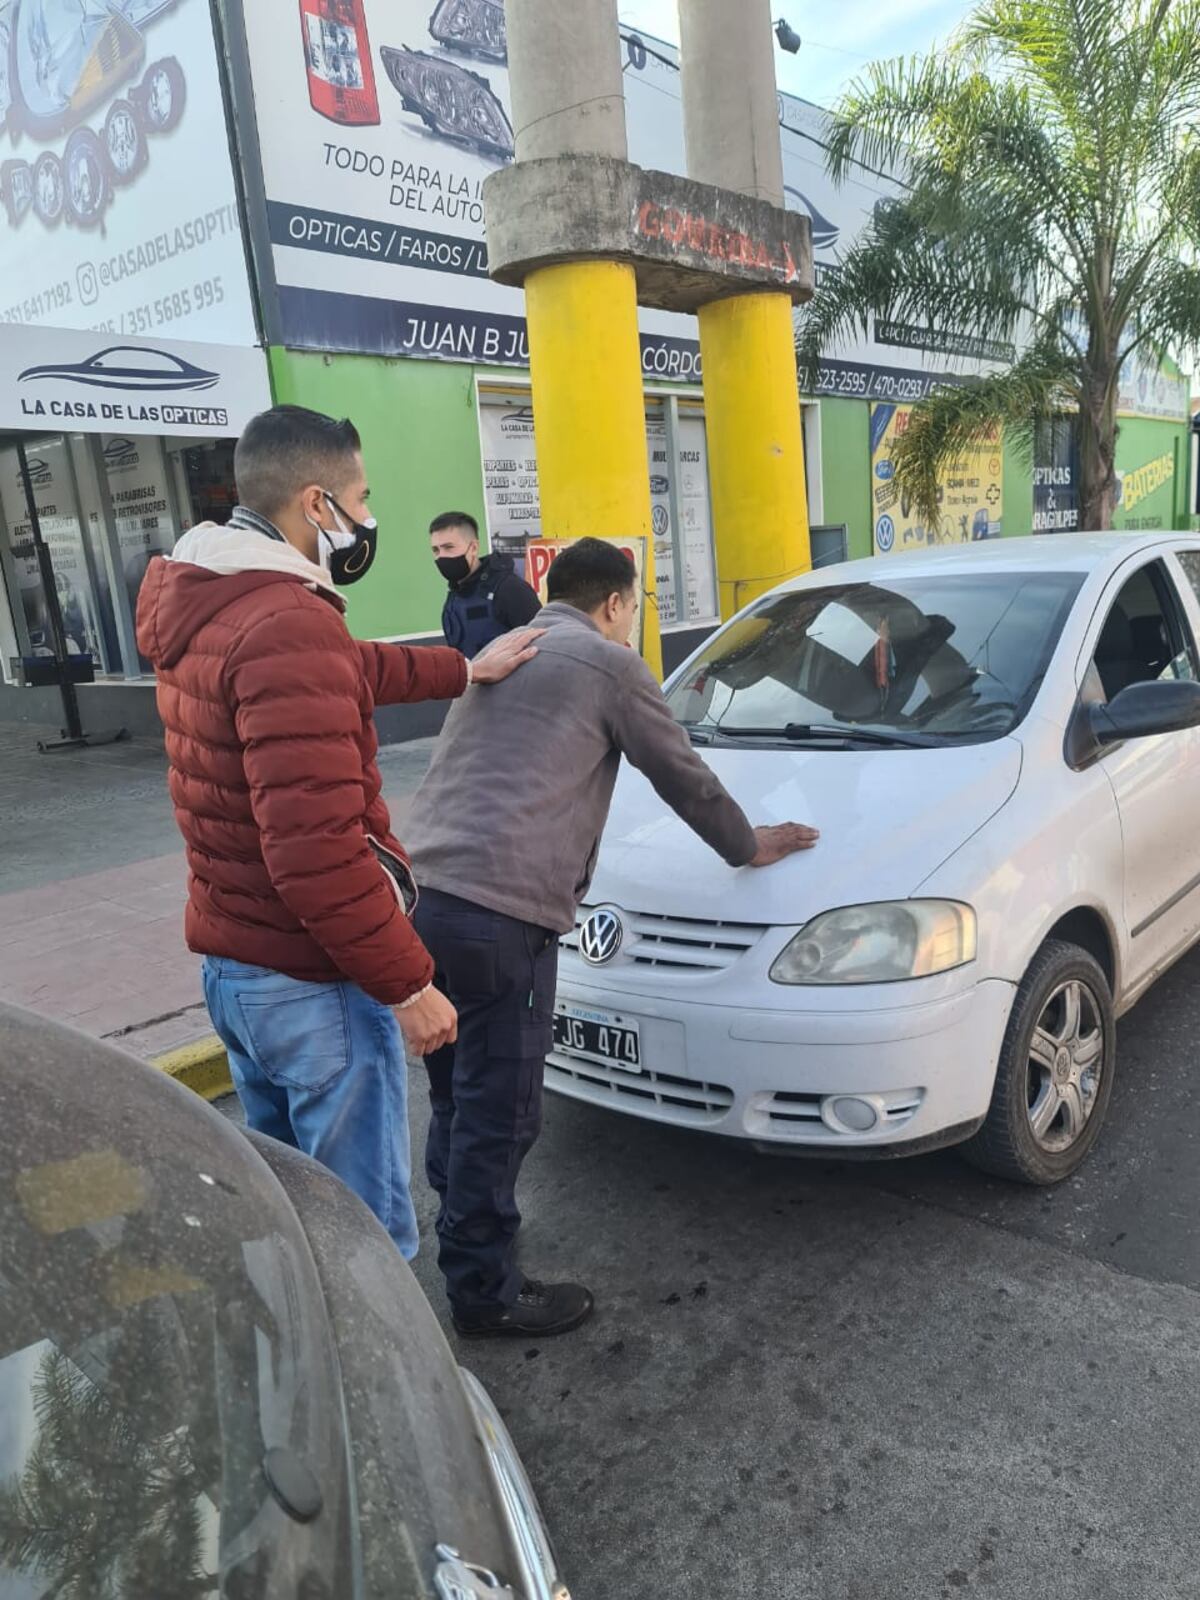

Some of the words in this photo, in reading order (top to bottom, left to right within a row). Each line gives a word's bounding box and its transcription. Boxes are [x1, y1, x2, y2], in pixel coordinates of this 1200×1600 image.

[323, 142, 385, 177] TODO
[390, 159, 442, 191] PARA
[448, 173, 470, 198] LA
[389, 184, 428, 212] DEL
[432, 195, 486, 225] AUTO
[289, 216, 383, 253] OPTICAS
[398, 236, 462, 267] FAROS
[153, 288, 192, 325] 5685
[193, 275, 225, 311] 995
[403, 318, 476, 354] JUAN
[483, 327, 501, 356] B
[642, 342, 703, 376] CÓRDO
[874, 375, 923, 399] 470-0293
[21, 398, 47, 416] LA
[50, 400, 98, 418] CASA
[101, 404, 124, 419] DE
[127, 405, 160, 421] LAS
[162, 406, 228, 425] OPTICAS
[1122, 452, 1174, 513] BATERIAS
[599, 1026, 637, 1063] 474
